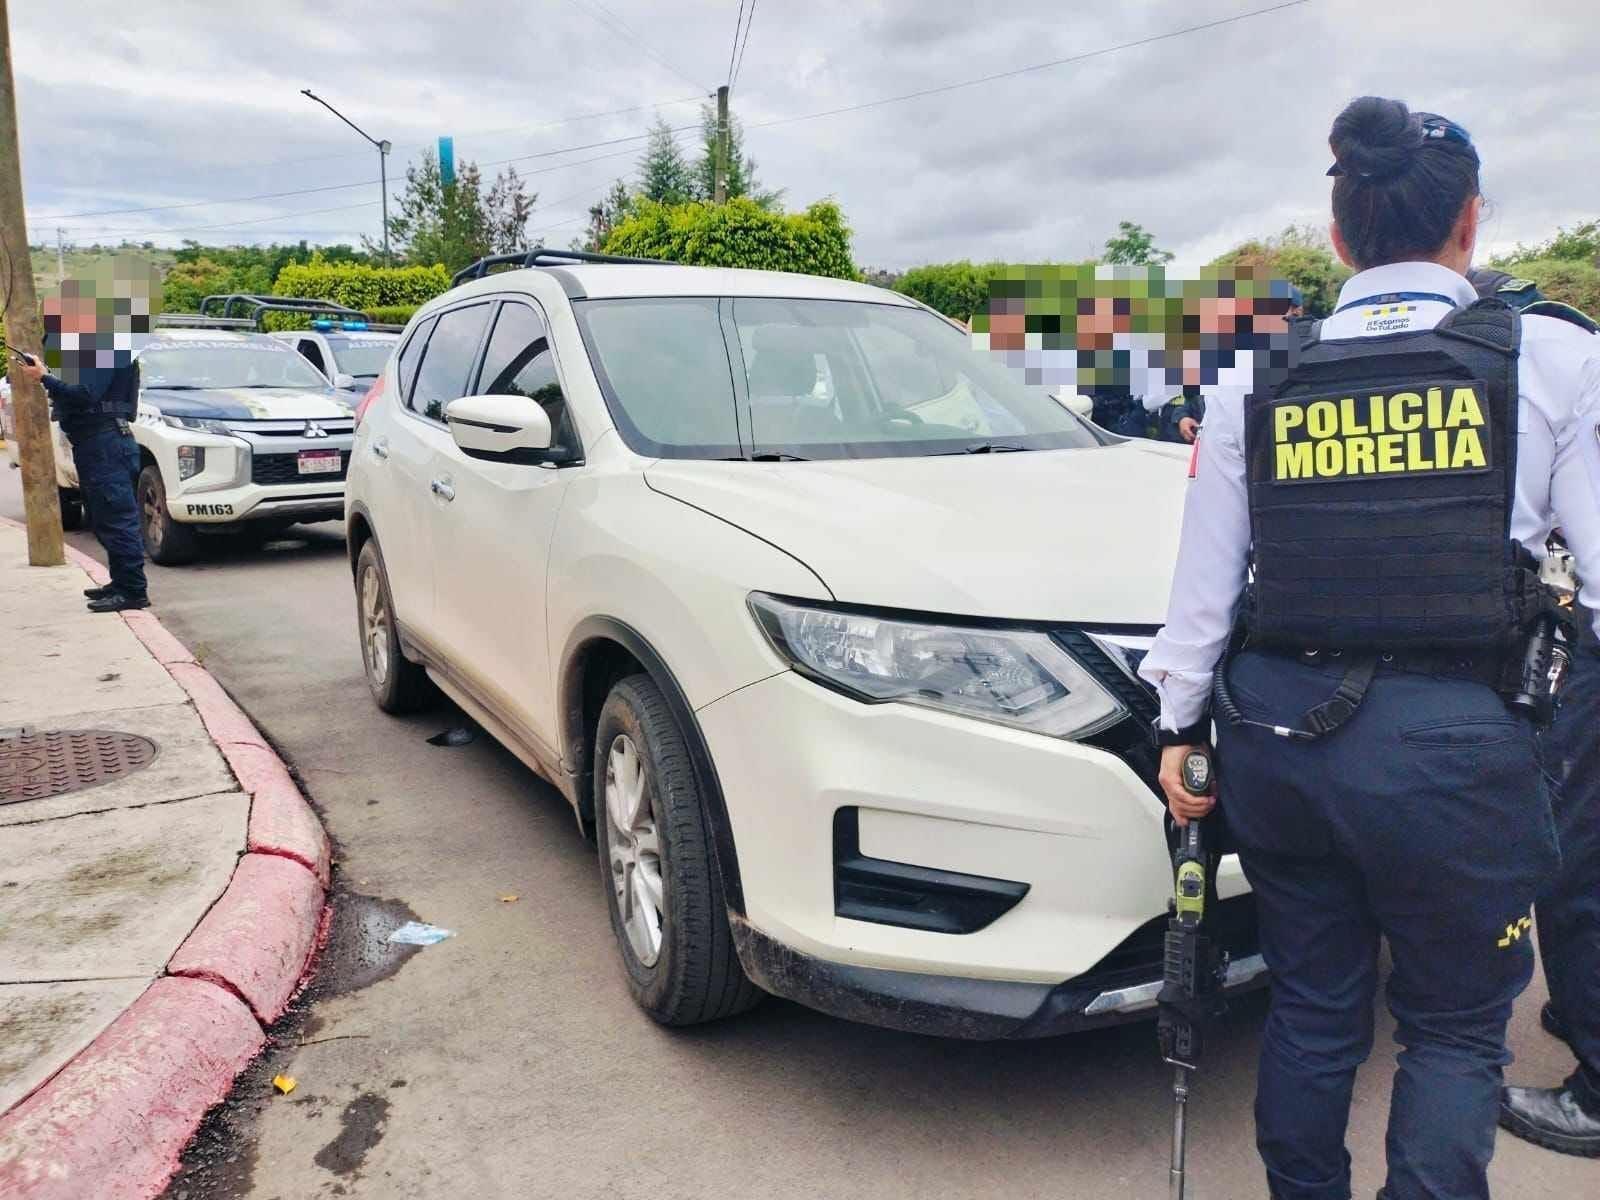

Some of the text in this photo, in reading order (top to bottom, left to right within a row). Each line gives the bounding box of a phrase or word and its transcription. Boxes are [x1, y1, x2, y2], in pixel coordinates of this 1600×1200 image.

[1275, 387, 1485, 442] POLICÍA
[1276, 428, 1487, 480] MORELIA
[187, 504, 234, 515] PM163
